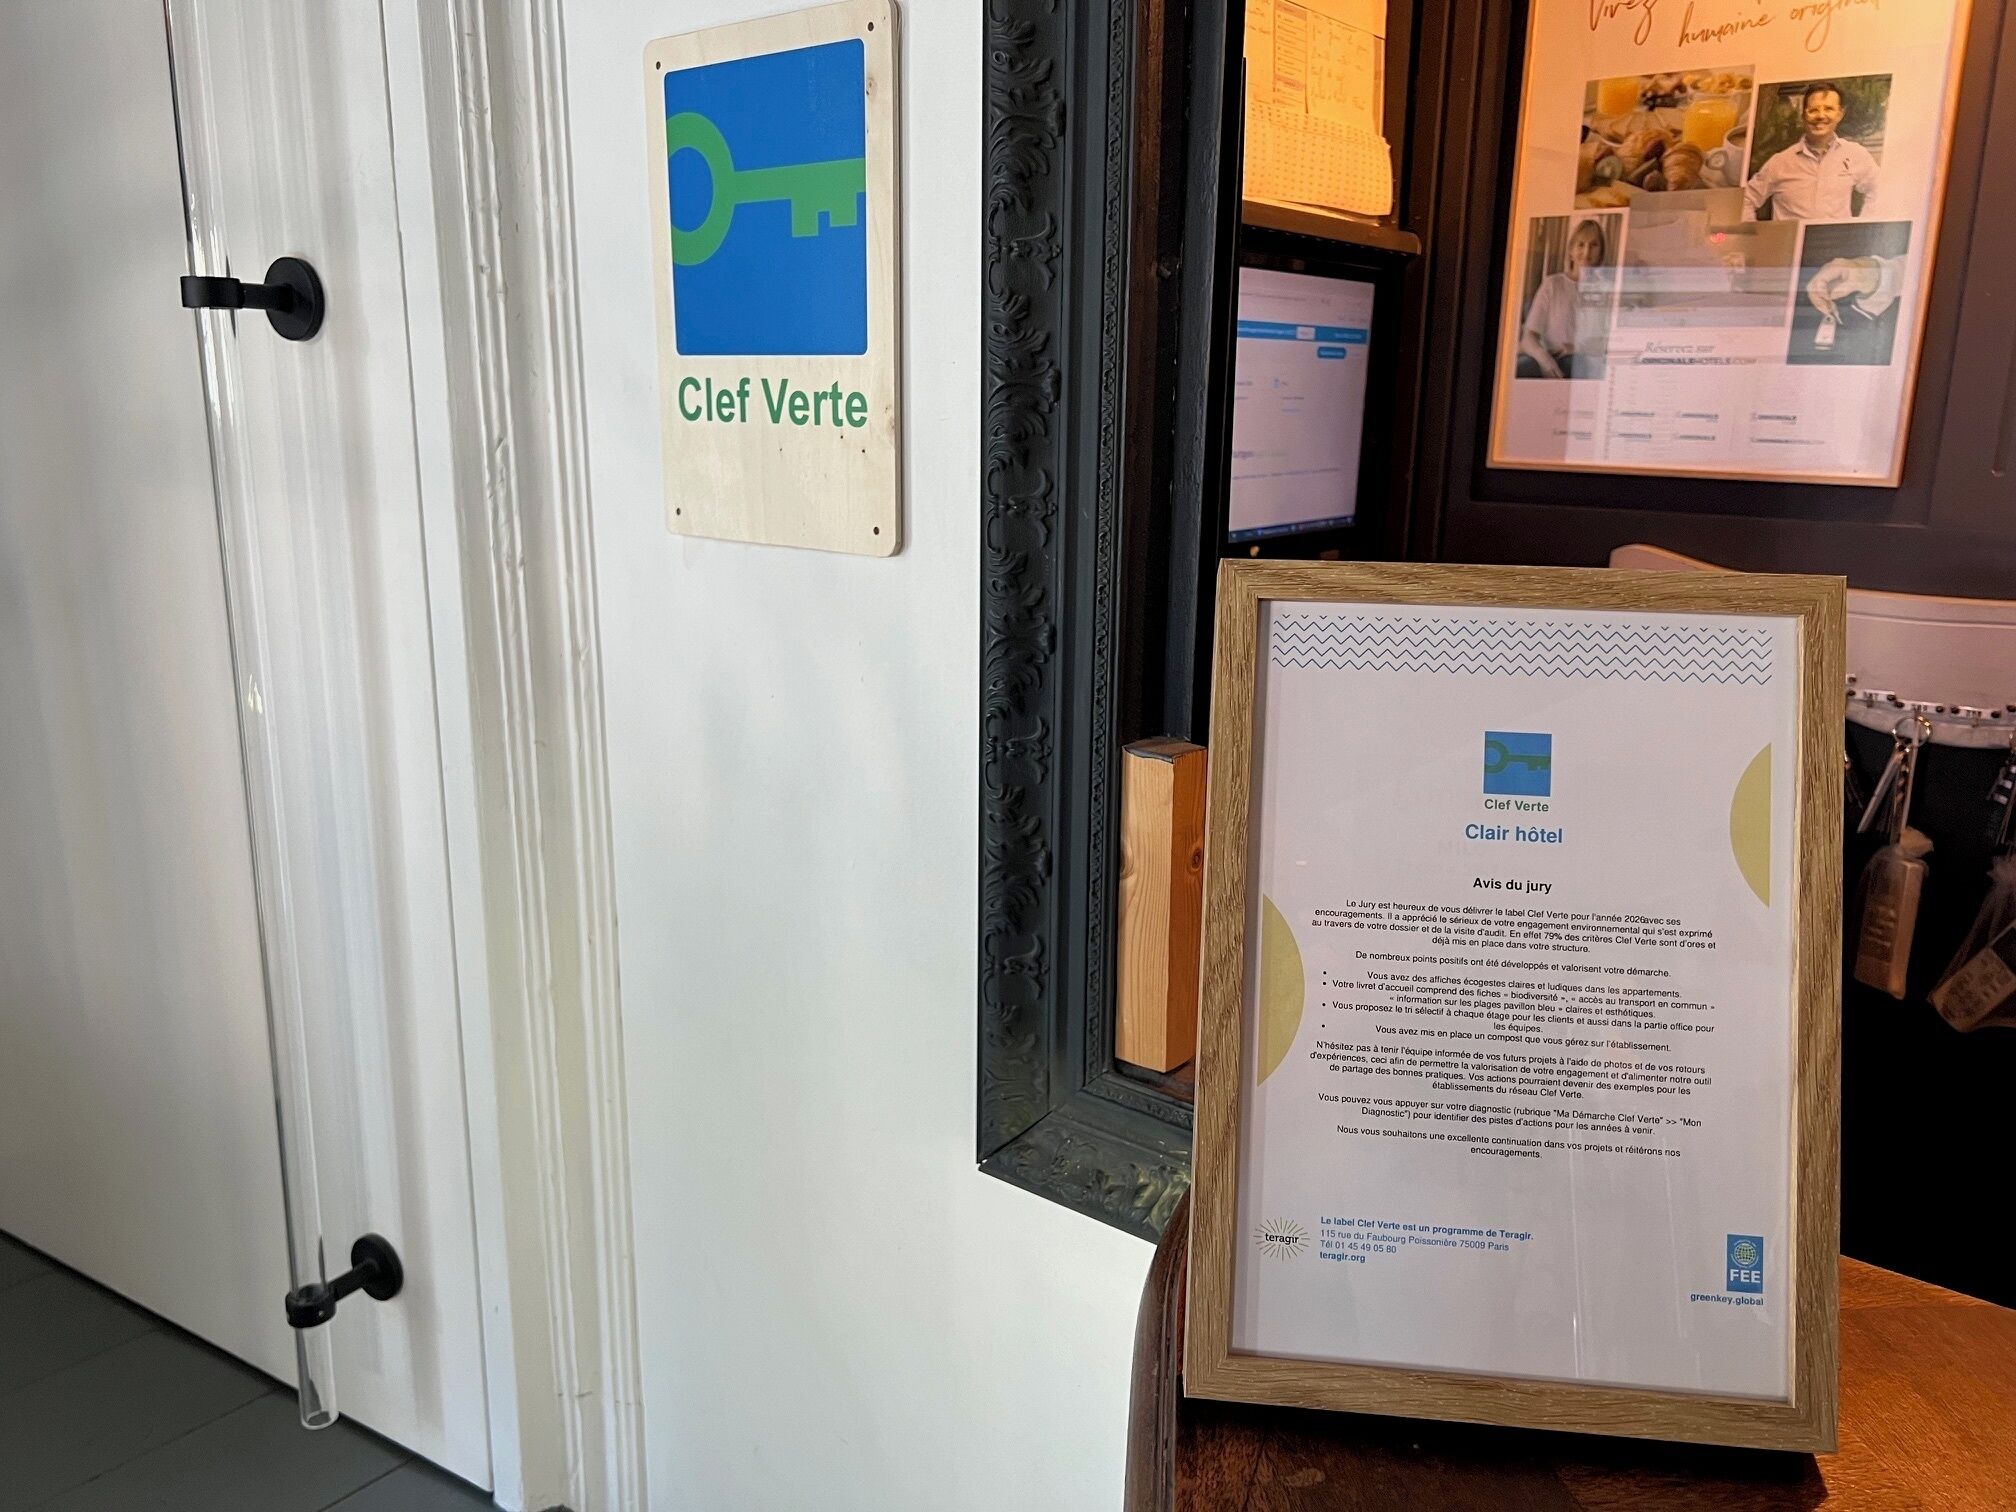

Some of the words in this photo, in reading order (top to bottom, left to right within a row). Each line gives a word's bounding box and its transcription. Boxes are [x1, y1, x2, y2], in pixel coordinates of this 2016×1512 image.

[678, 376, 750, 423] Clef
[761, 378, 868, 428] Verte
[1484, 799, 1511, 811] Clef
[1514, 800, 1549, 812] Verte
[1465, 824, 1509, 841] Clair
[1515, 826, 1563, 844] hôtel
[1473, 877, 1502, 889] Avis
[1505, 879, 1522, 891] du
[1526, 879, 1552, 894] jury
[1346, 899, 1356, 907] Le
[1357, 900, 1376, 910] Jury
[1377, 901, 1392, 909] est
[1392, 902, 1426, 911] heureux
[1427, 904, 1438, 912] de
[1462, 906, 1493, 914] délivrer
[1504, 908, 1525, 916] label
[1527, 909, 1544, 917] Clef
[1546, 910, 1568, 919] Verte
[1570, 914, 1590, 922] pour
[1591, 913, 1622, 922] l'année
[1314, 910, 1384, 921] encouragements.
[1386, 912, 1392, 920] Il
[1400, 913, 1437, 924] apprécié
[1439, 915, 1447, 923] le
[1448, 916, 1479, 924] sérieux
[1493, 918, 1515, 926] votre
[1516, 920, 1569, 932] engagement
[1570, 923, 1640, 934] environnemental
[1641, 927, 1655, 936] qui
[1657, 927, 1678, 936] s'est
[1678, 929, 1712, 940] exprimé
[1431, 936, 1450, 946] déjà
[1451, 937, 1466, 945] mis
[1481, 939, 1504, 949] place
[1505, 940, 1526, 948] dans
[1528, 941, 1549, 950] votre
[1551, 943, 1590, 952] structure.
[1355, 951, 1367, 959] De
[1369, 952, 1410, 961] nombreux
[1412, 954, 1437, 965] points
[1439, 956, 1468, 966] positifs
[1500, 959, 1548, 971] développés
[1550, 962, 1558, 970] et
[1561, 963, 1601, 972] valorisent
[1603, 965, 1624, 974] votre
[1626, 967, 1671, 976] démarche.
[1366, 971, 1388, 980] Vous
[1411, 974, 1427, 982] des
[1429, 975, 1461, 984] affiches
[1463, 977, 1506, 989] écogestes
[1507, 980, 1535, 988] claires
[1547, 982, 1582, 993] ludiques
[1584, 984, 1605, 993] dans
[1607, 986, 1620, 994] les
[1622, 987, 1681, 999] appartements.
[1332, 1001, 1353, 1010] Vous
[1355, 1005, 1393, 1014] proposez
[1395, 1005, 1402, 1013] le
[1414, 1006, 1444, 1015] sélectif
[1453, 1009, 1484, 1020] chaque
[1486, 1011, 1510, 1021] étage
[1511, 1014, 1531, 1023] pour
[1547, 1015, 1574, 1023] clients
[1576, 1016, 1584, 1024] et
[1586, 1017, 1609, 1025] aussi
[1610, 1019, 1632, 1027] dans
[1643, 1021, 1668, 1031] partie
[1669, 1022, 1693, 1031] office
[1695, 1025, 1714, 1034] pour
[1375, 1025, 1396, 1034] Vous
[1420, 1028, 1435, 1036] mis
[1449, 1030, 1472, 1040] place
[1486, 1032, 1522, 1044] compost
[1524, 1037, 1540, 1045] que
[1564, 1037, 1588, 1048] gérez
[1493, 1022, 1506, 1030] les
[1507, 1023, 1543, 1034] équipes.
[1432, 1081, 1494, 1092] établissements
[1495, 1085, 1506, 1093] du
[1508, 1086, 1538, 1095] réseau
[1539, 1088, 1557, 1096] Clef
[1558, 1090, 1583, 1098] Verte.
[1412, 1112, 1432, 1121] pour
[1433, 1112, 1469, 1121] identifier
[1470, 1114, 1486, 1122] des
[1488, 1116, 1513, 1126] pistes
[1515, 1117, 1552, 1127] d'actions
[1554, 1122, 1574, 1130] pour
[1576, 1122, 1588, 1130] les
[1590, 1123, 1622, 1132] années
[1631, 1125, 1654, 1134] venir.
[1470, 1147, 1542, 1159] encouragements.
[1320, 1215, 1331, 1224] Le
[1333, 1216, 1354, 1226] label
[1357, 1218, 1374, 1227] Clef
[1377, 1219, 1400, 1229] Verte
[1402, 1221, 1416, 1231] est
[1418, 1224, 1430, 1232] un
[1432, 1225, 1483, 1238] programme
[1485, 1227, 1497, 1237] de
[1265, 1232, 1299, 1244] teragir
[1321, 1228, 1335, 1237] 115
[1353, 1230, 1364, 1239] du
[1366, 1231, 1406, 1245] Faubourg
[1459, 1238, 1485, 1249] 75009
[1487, 1240, 1509, 1251] Paris
[1334, 1239, 1344, 1249] 01
[1347, 1240, 1358, 1250] 45
[1360, 1241, 1371, 1251] 49
[1373, 1242, 1383, 1252] 05
[1386, 1243, 1396, 1253] 80
[1729, 1268, 1761, 1284] FEE
[1690, 1293, 1764, 1306] greenkey.global
